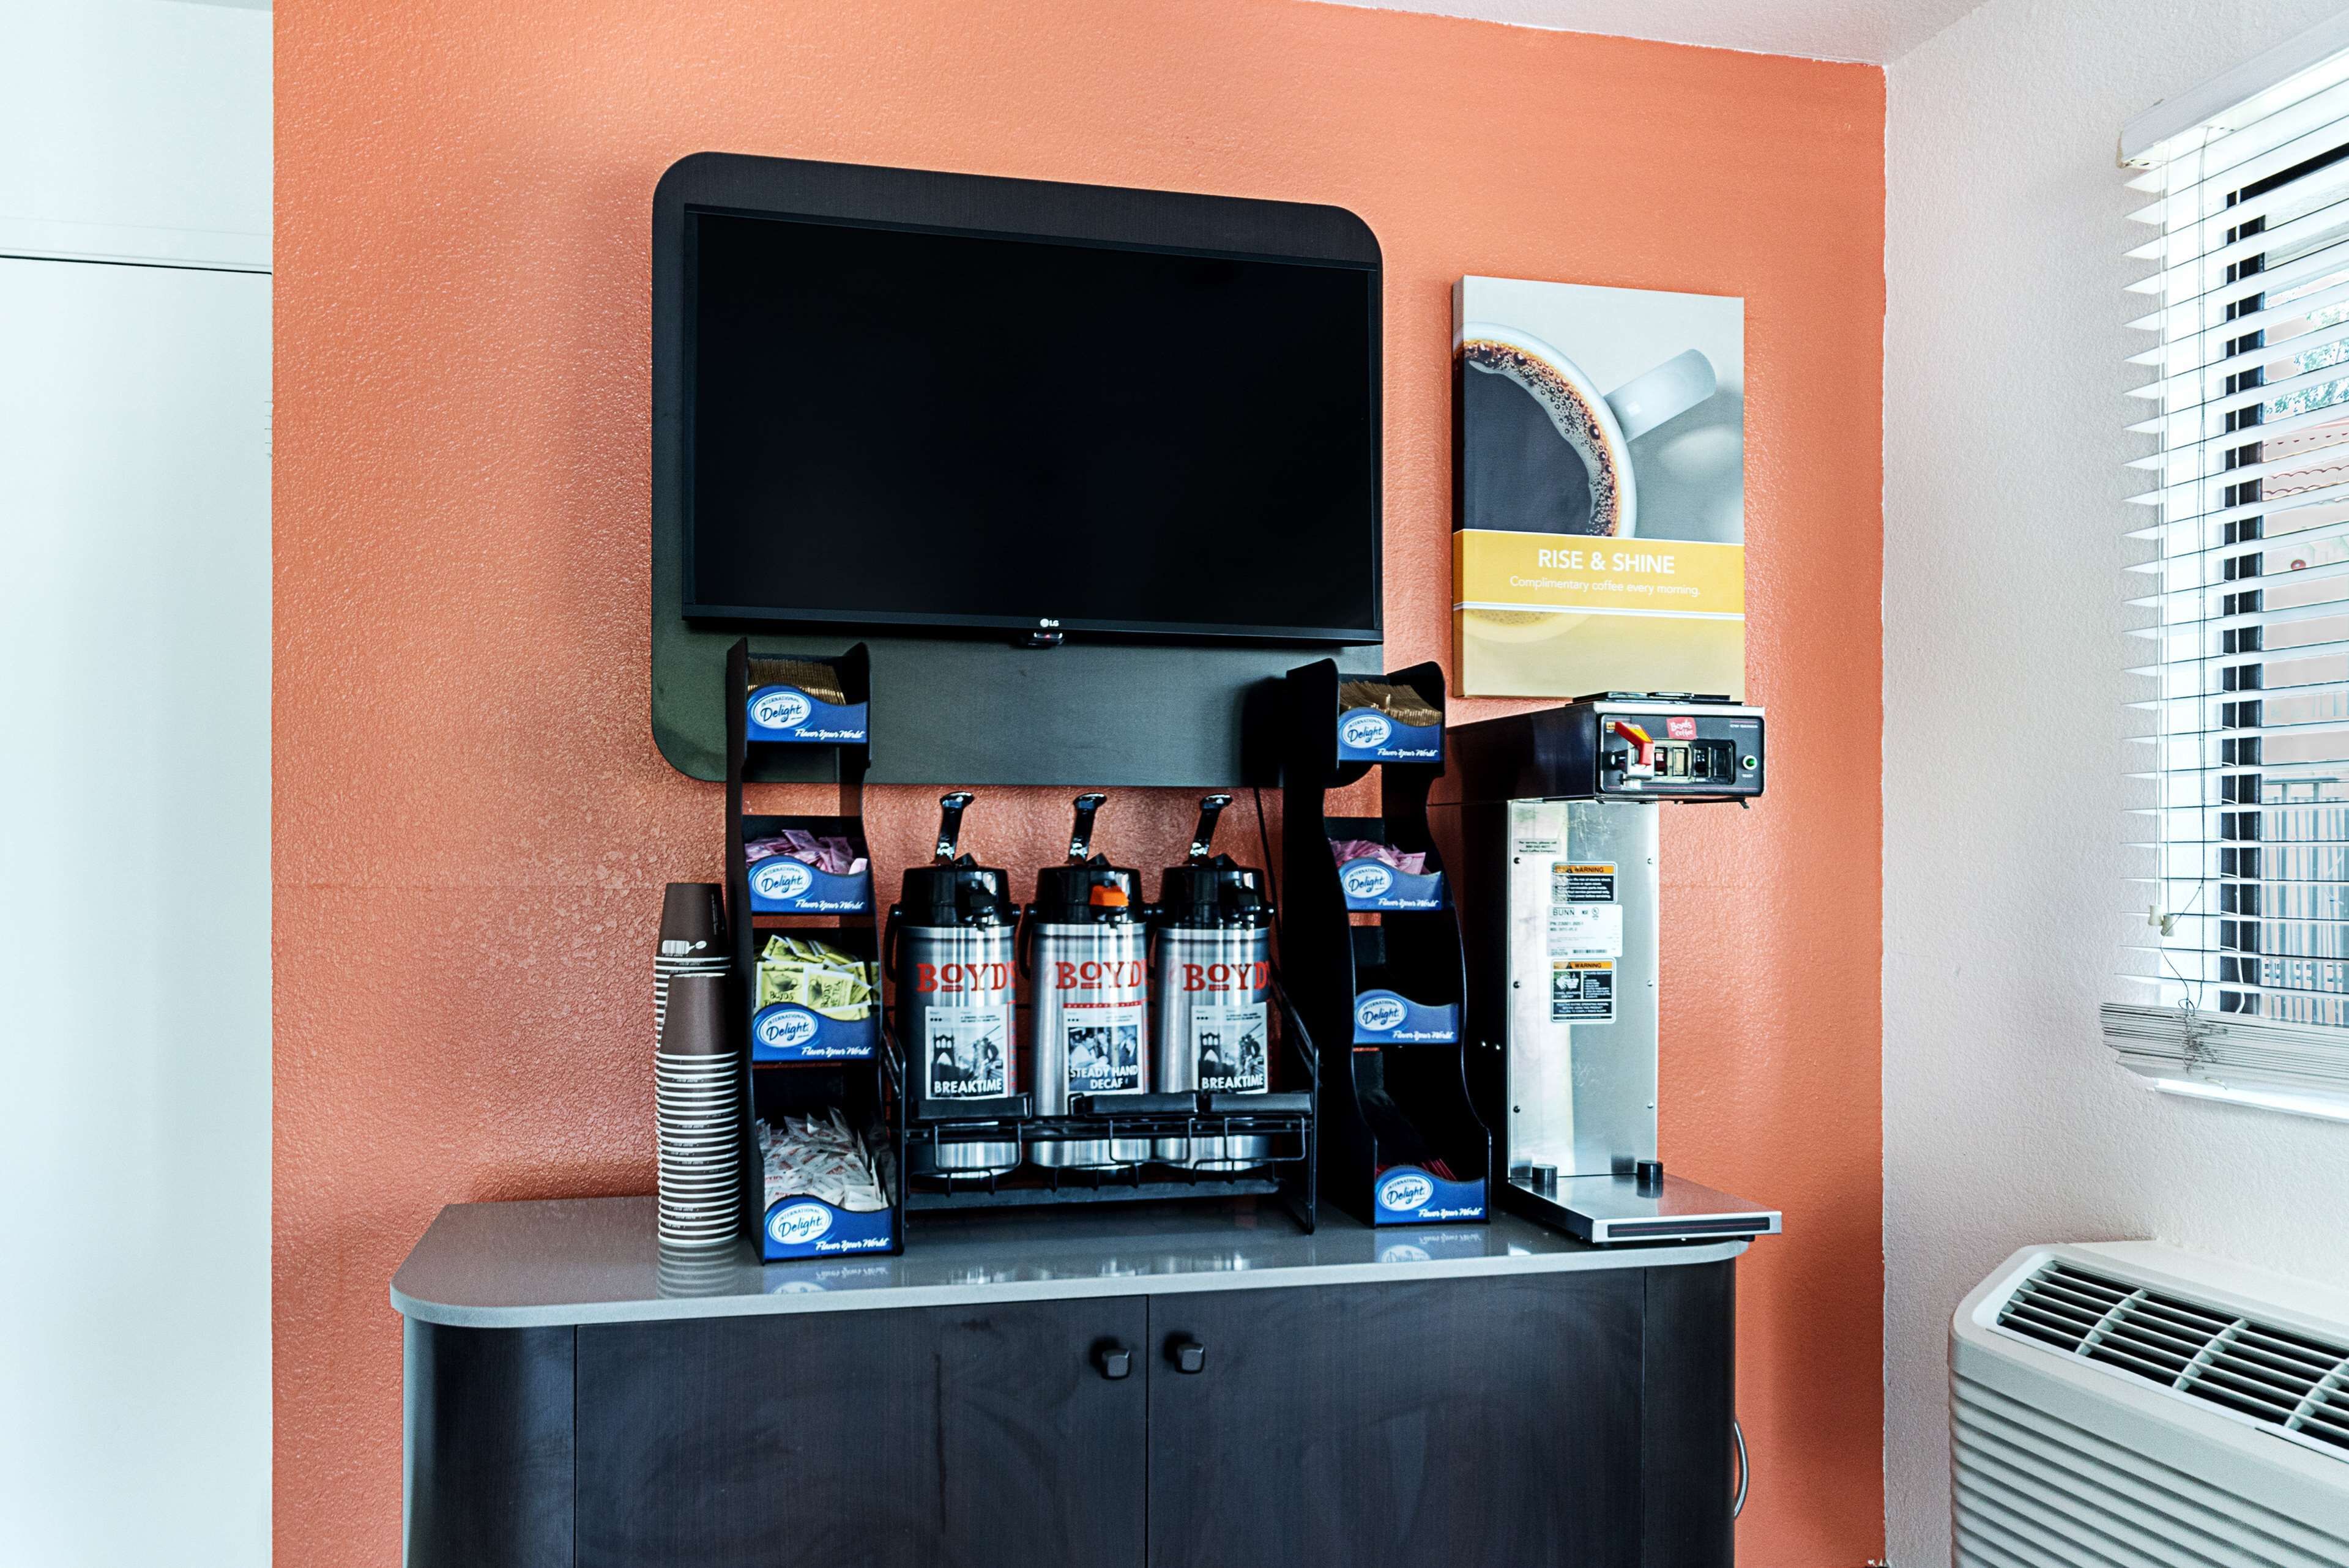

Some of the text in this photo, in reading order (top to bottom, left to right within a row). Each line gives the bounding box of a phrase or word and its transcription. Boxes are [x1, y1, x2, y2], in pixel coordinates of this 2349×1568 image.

[1538, 549, 1675, 574] RISE & SHINE
[1510, 575, 1701, 598] Complimentary coffee every morning.
[761, 704, 803, 723] Delight
[795, 729, 866, 740] Flavor Your World
[1347, 726, 1383, 743] Delight
[1398, 749, 1415, 758] Your
[761, 875, 803, 893] Delight
[1349, 876, 1385, 893] Delight
[795, 899, 818, 908] Flavor
[819, 900, 839, 911] Your
[1378, 897, 1399, 906] Flavor
[1399, 898, 1416, 908] Your
[1362, 1008, 1400, 1025] Delight
[766, 1022, 810, 1041] Delight
[1393, 1030, 1455, 1041] Flavor Your World
[801, 1047, 873, 1058] Flavor Your World
[1070, 1065, 1138, 1078] STEADY HAND
[934, 1078, 1002, 1094] BREAKTIME
[1090, 1077, 1123, 1090] DECAF
[1202, 1074, 1264, 1090] BREAKTIME
[1387, 1186, 1424, 1205] Delight
[1418, 1207, 1483, 1219] Flavor Your World
[778, 1215, 822, 1238] Delight
[816, 1237, 890, 1252] Flavor Your World
